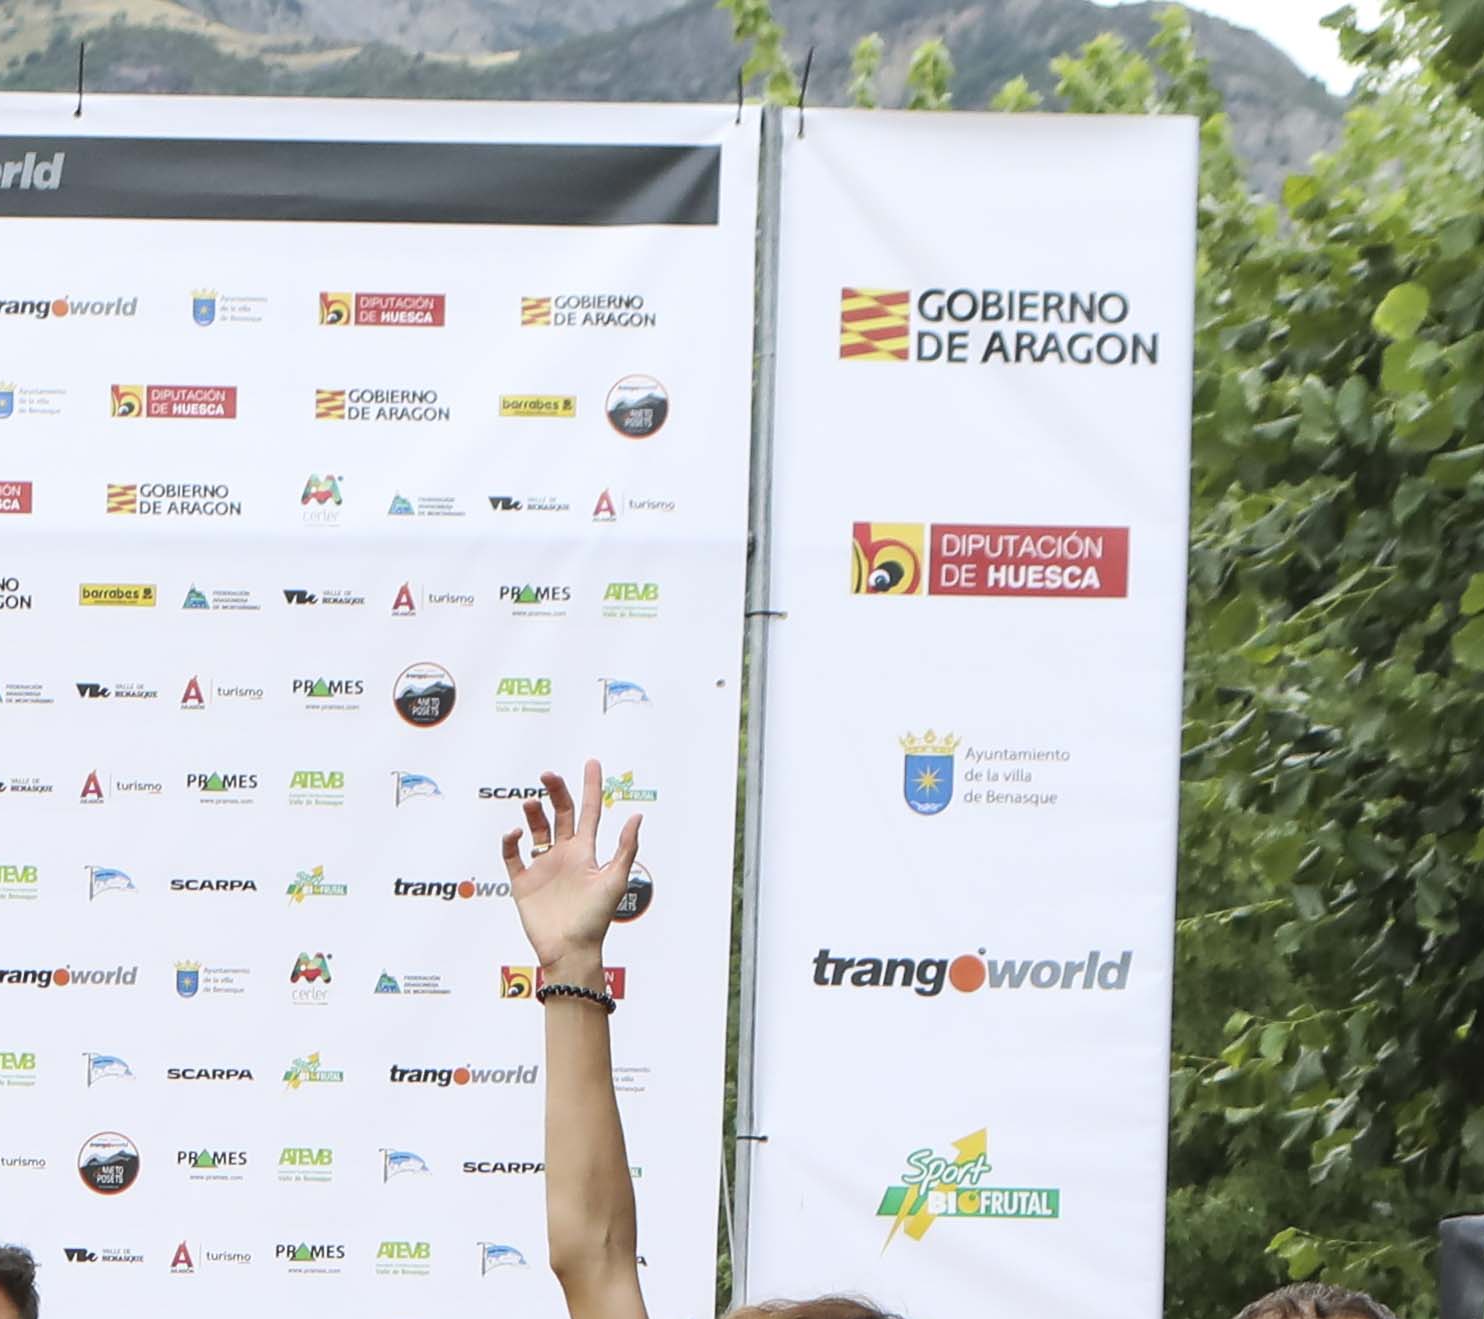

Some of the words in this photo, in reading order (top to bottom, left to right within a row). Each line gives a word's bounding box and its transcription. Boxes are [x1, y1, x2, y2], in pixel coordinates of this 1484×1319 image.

[555, 296, 643, 310] GOBIERNO
[918, 289, 1128, 324] GOBIERNO
[554, 312, 576, 326] DE
[582, 312, 655, 327] ARAGON
[917, 331, 969, 363] DE
[981, 331, 1157, 365] ARAGON
[151, 388, 225, 401] DIPUTACIÓN
[152, 403, 168, 414] DE
[173, 403, 224, 415] HUESCA
[140, 484, 228, 498] GOBIERNO
[140, 501, 161, 514] DE
[167, 502, 241, 515] ARAGON
[629, 500, 675, 512] turismo
[941, 532, 1102, 558] DIPUTACIÓN
[941, 564, 976, 587] DE
[988, 565, 1100, 589] HUESCA
[218, 688, 263, 699] turismo
[965, 747, 1070, 763] Ayuntamiento
[964, 769, 983, 781] de
[987, 768, 999, 782] la
[1003, 768, 1032, 782] villa
[964, 790, 982, 803] de
[986, 790, 1057, 806] Benasque
[171, 880, 256, 891] SCARPA
[813, 949, 1131, 997] trangoworld
[168, 1069, 253, 1080] SCARPA
[390, 1065, 537, 1087] trangoworld
[902, 1148, 992, 1196] Sport
